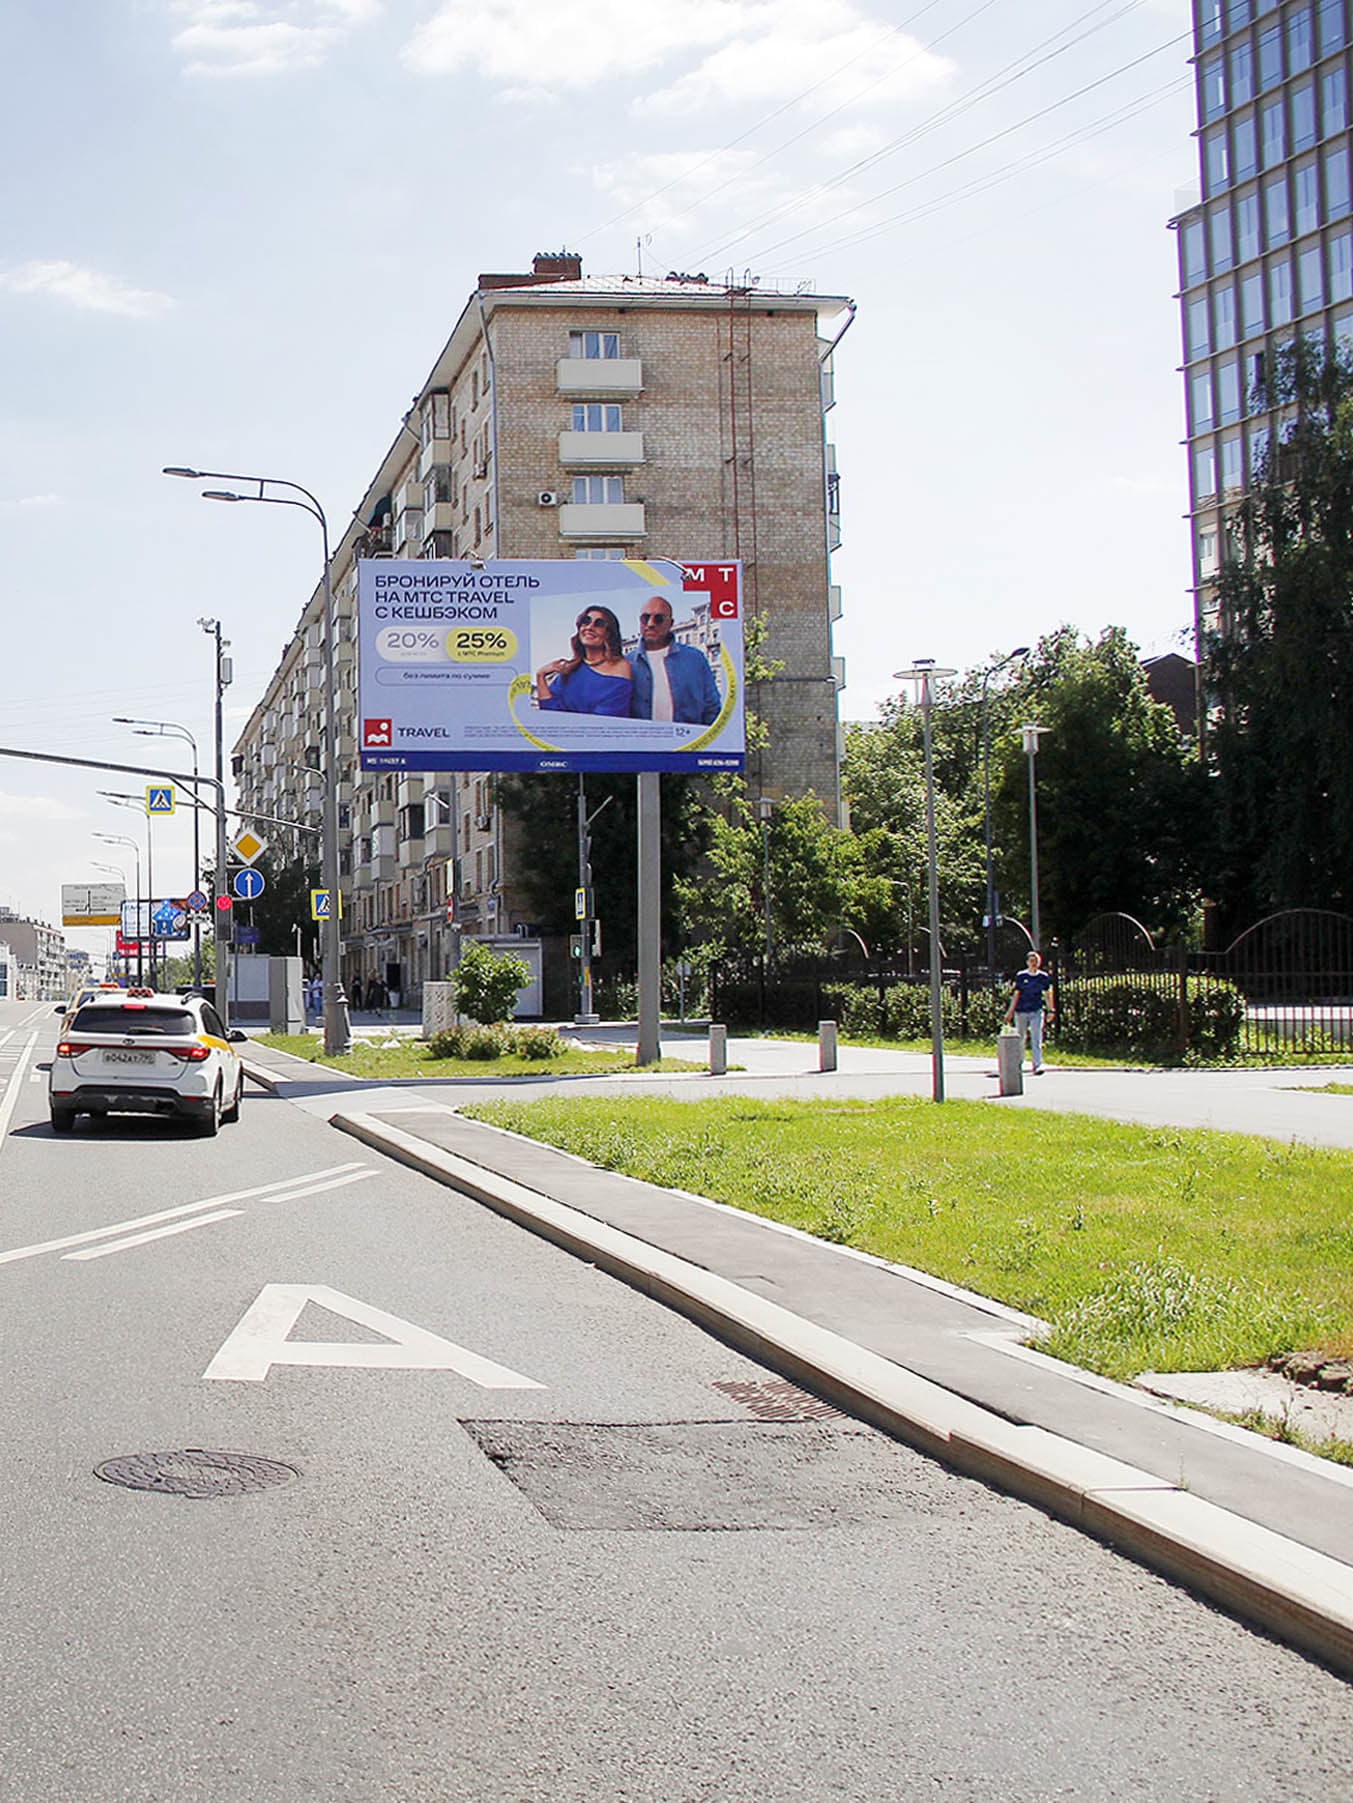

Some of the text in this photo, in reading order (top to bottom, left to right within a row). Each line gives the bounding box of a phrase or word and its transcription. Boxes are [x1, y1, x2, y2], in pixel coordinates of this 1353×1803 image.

[375, 573, 540, 588] БРОНИРУЙ ОТЕЛЬ
[375, 591, 514, 603] НА МТС TRAVEL
[375, 606, 497, 619] С КЕШБЭКОМ
[387, 632, 439, 648] 20%
[457, 632, 508, 648] 25%
[398, 727, 450, 738] TRAVEL
[675, 727, 690, 738] 12+
